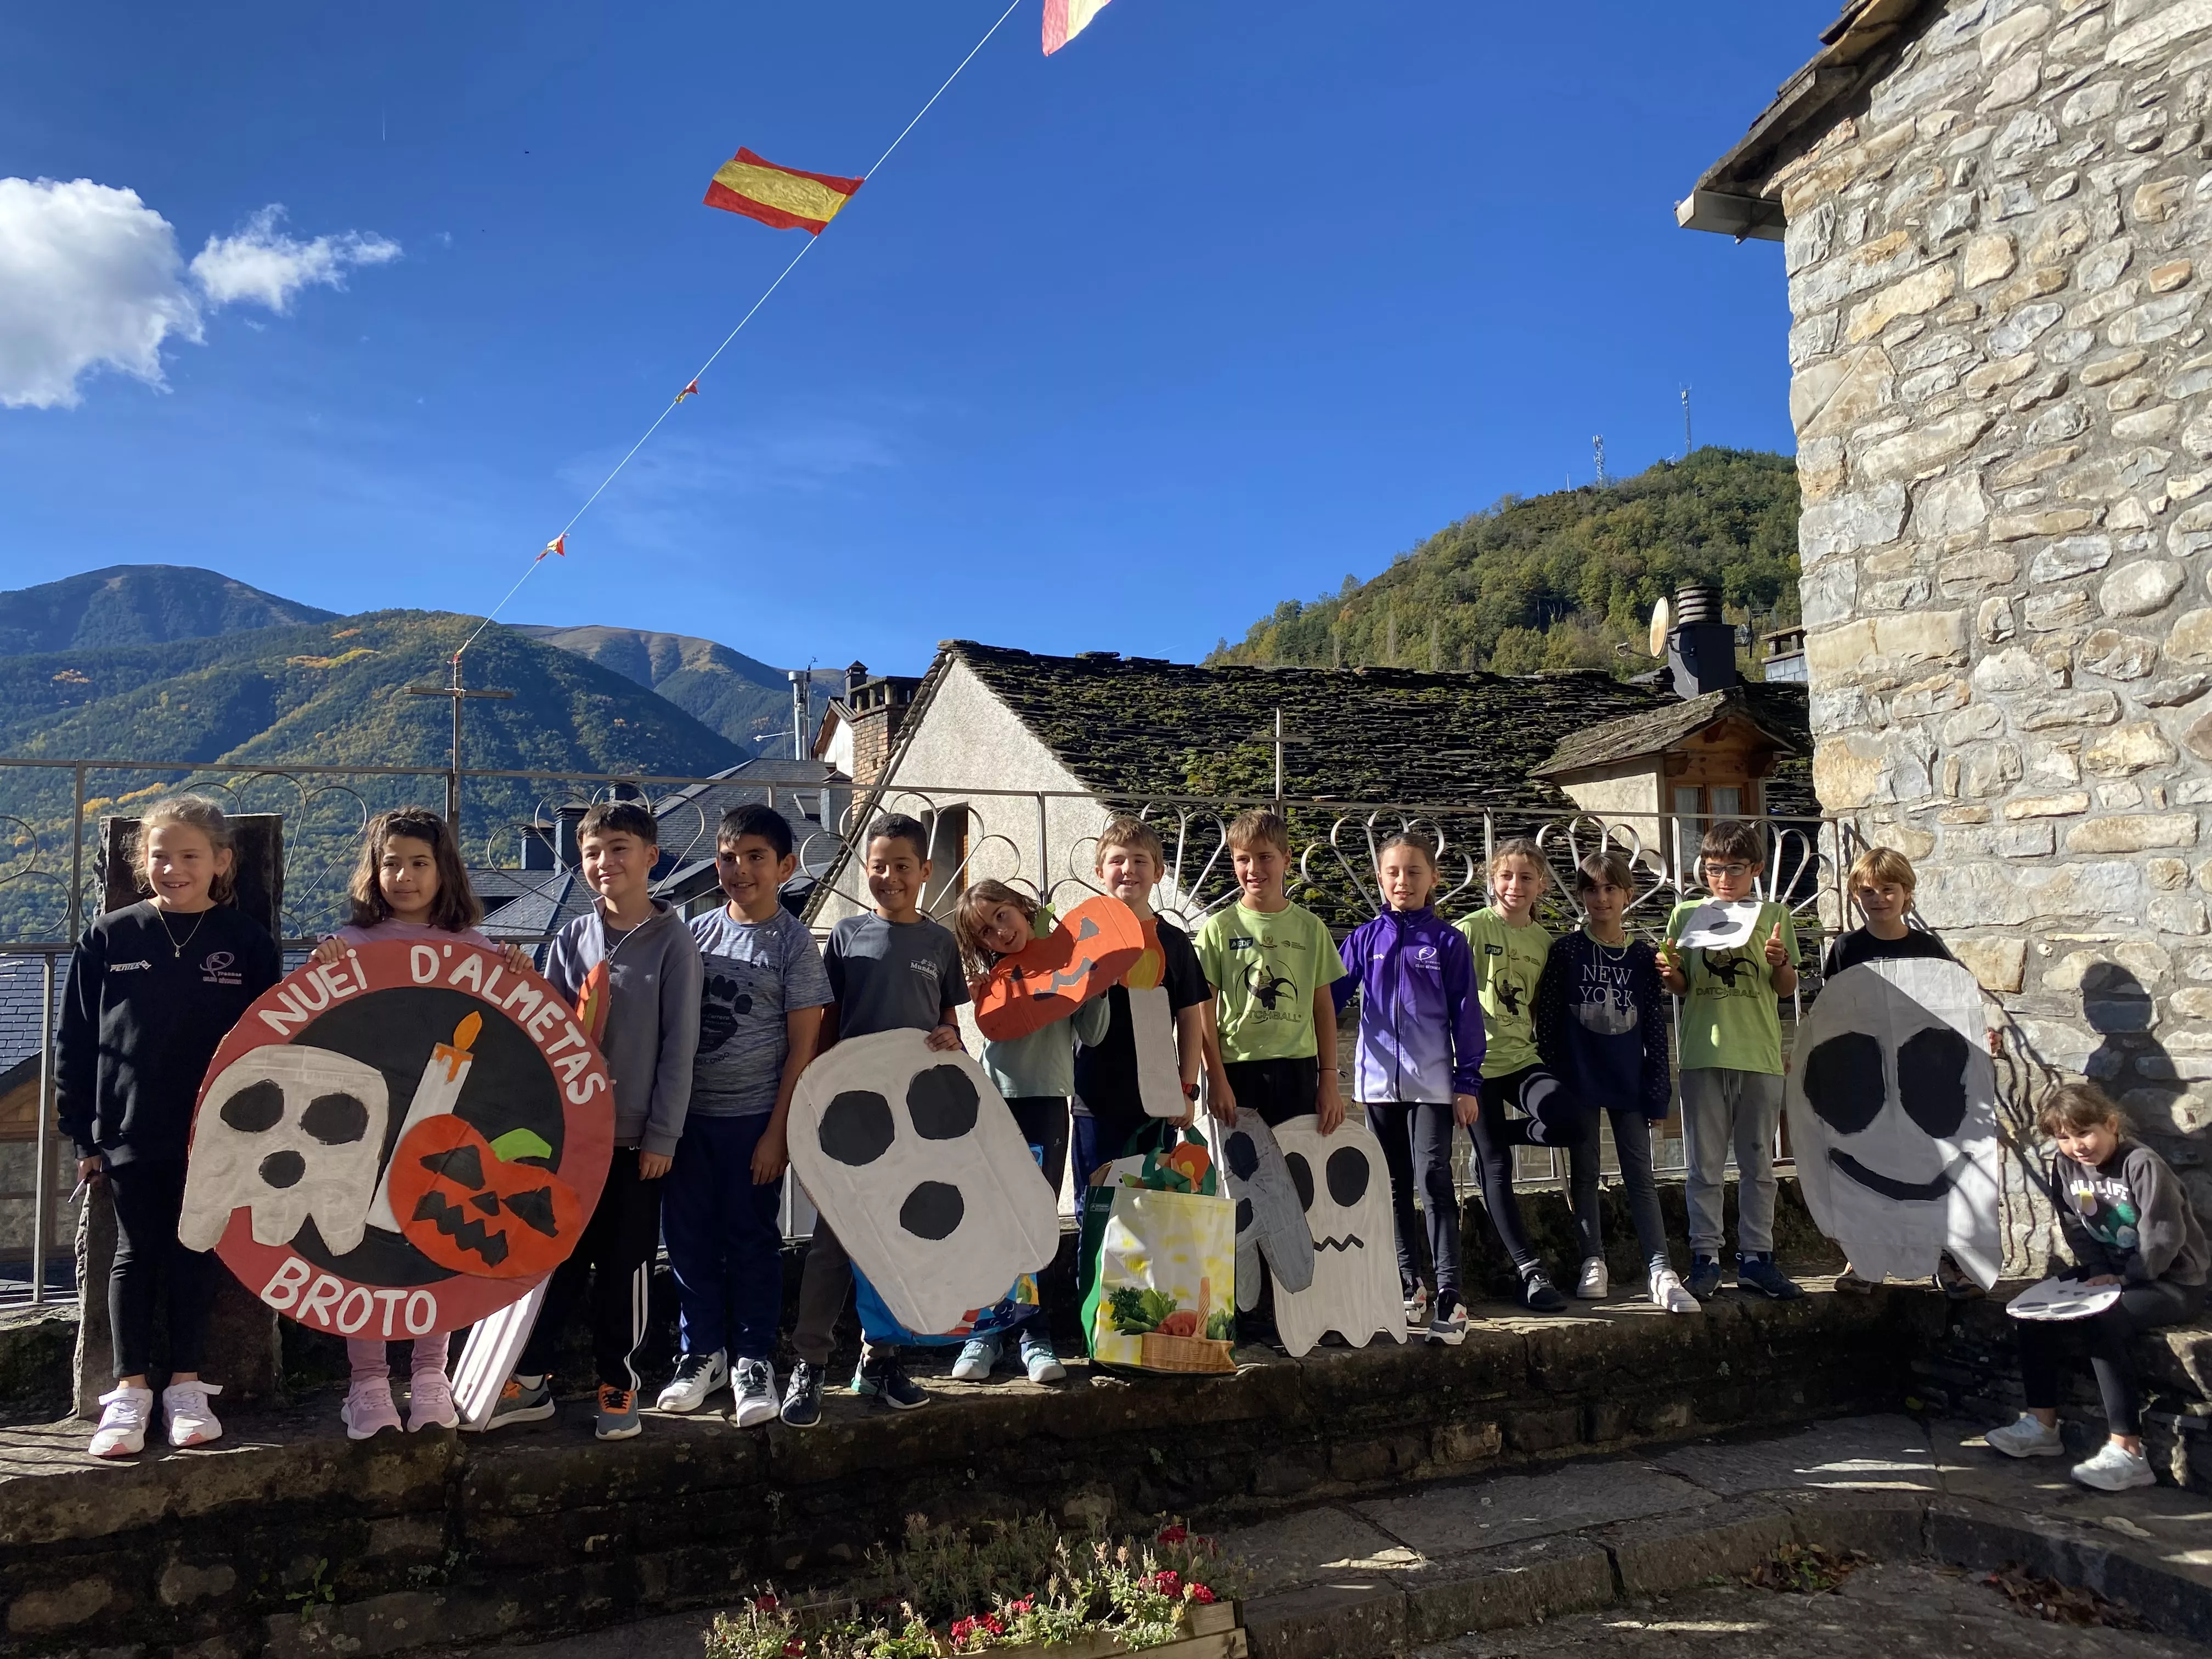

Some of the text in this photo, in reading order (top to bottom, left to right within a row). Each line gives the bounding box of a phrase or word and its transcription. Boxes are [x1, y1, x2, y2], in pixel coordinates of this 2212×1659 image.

[1237, 939, 1252, 947] EDF
[1582, 964, 1633, 985] NEW
[1578, 986, 1634, 1007] YORK
[410, 945, 606, 1104] D'ALMETAS
[260, 1256, 437, 1337] BROTO
